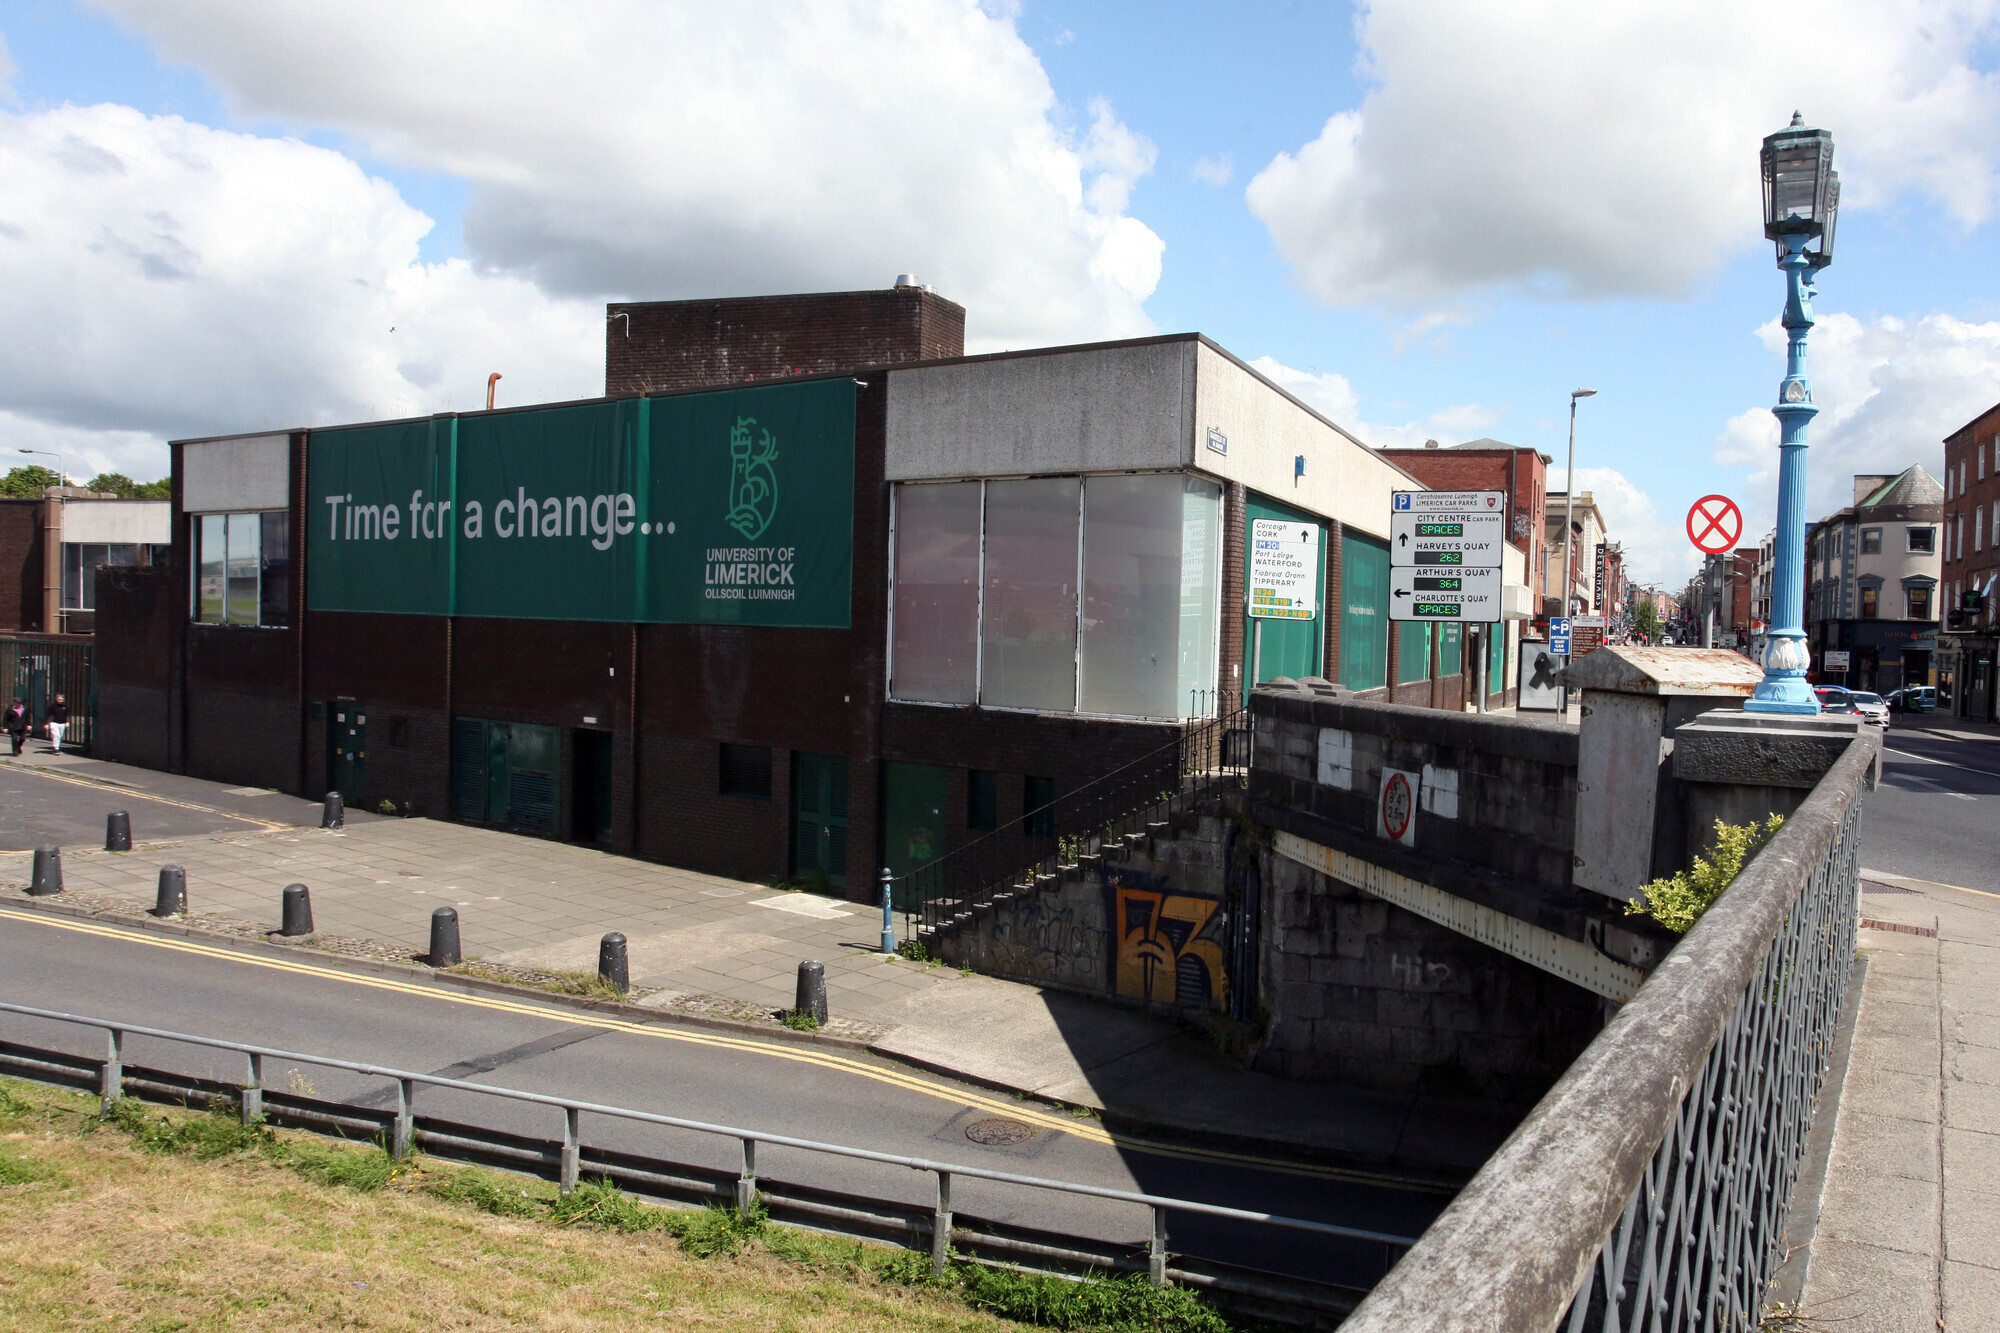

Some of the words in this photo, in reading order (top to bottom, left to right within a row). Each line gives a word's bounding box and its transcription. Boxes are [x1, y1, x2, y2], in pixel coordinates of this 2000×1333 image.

[326, 493, 400, 540] Time
[409, 490, 450, 538] for
[464, 500, 482, 539] a
[494, 486, 676, 550] change...
[1256, 522, 1287, 530] Corcaigh
[1421, 526, 1460, 534] SPACES
[706, 548, 775, 562] UNIVERSITY
[778, 548, 795, 561] OF
[1440, 553, 1460, 562] 262
[1255, 559, 1302, 568] WATERFORD
[705, 564, 794, 584] LIMERICK
[1254, 578, 1296, 586] TIPPERARY
[1439, 580, 1458, 588] 364
[705, 588, 746, 599] OLLSCOIL
[748, 589, 795, 600] LUIMNIGH
[1419, 605, 1458, 614] SPACES
[1910, 632, 1918, 640] &
[1388, 806, 1404, 820] 2.5m
